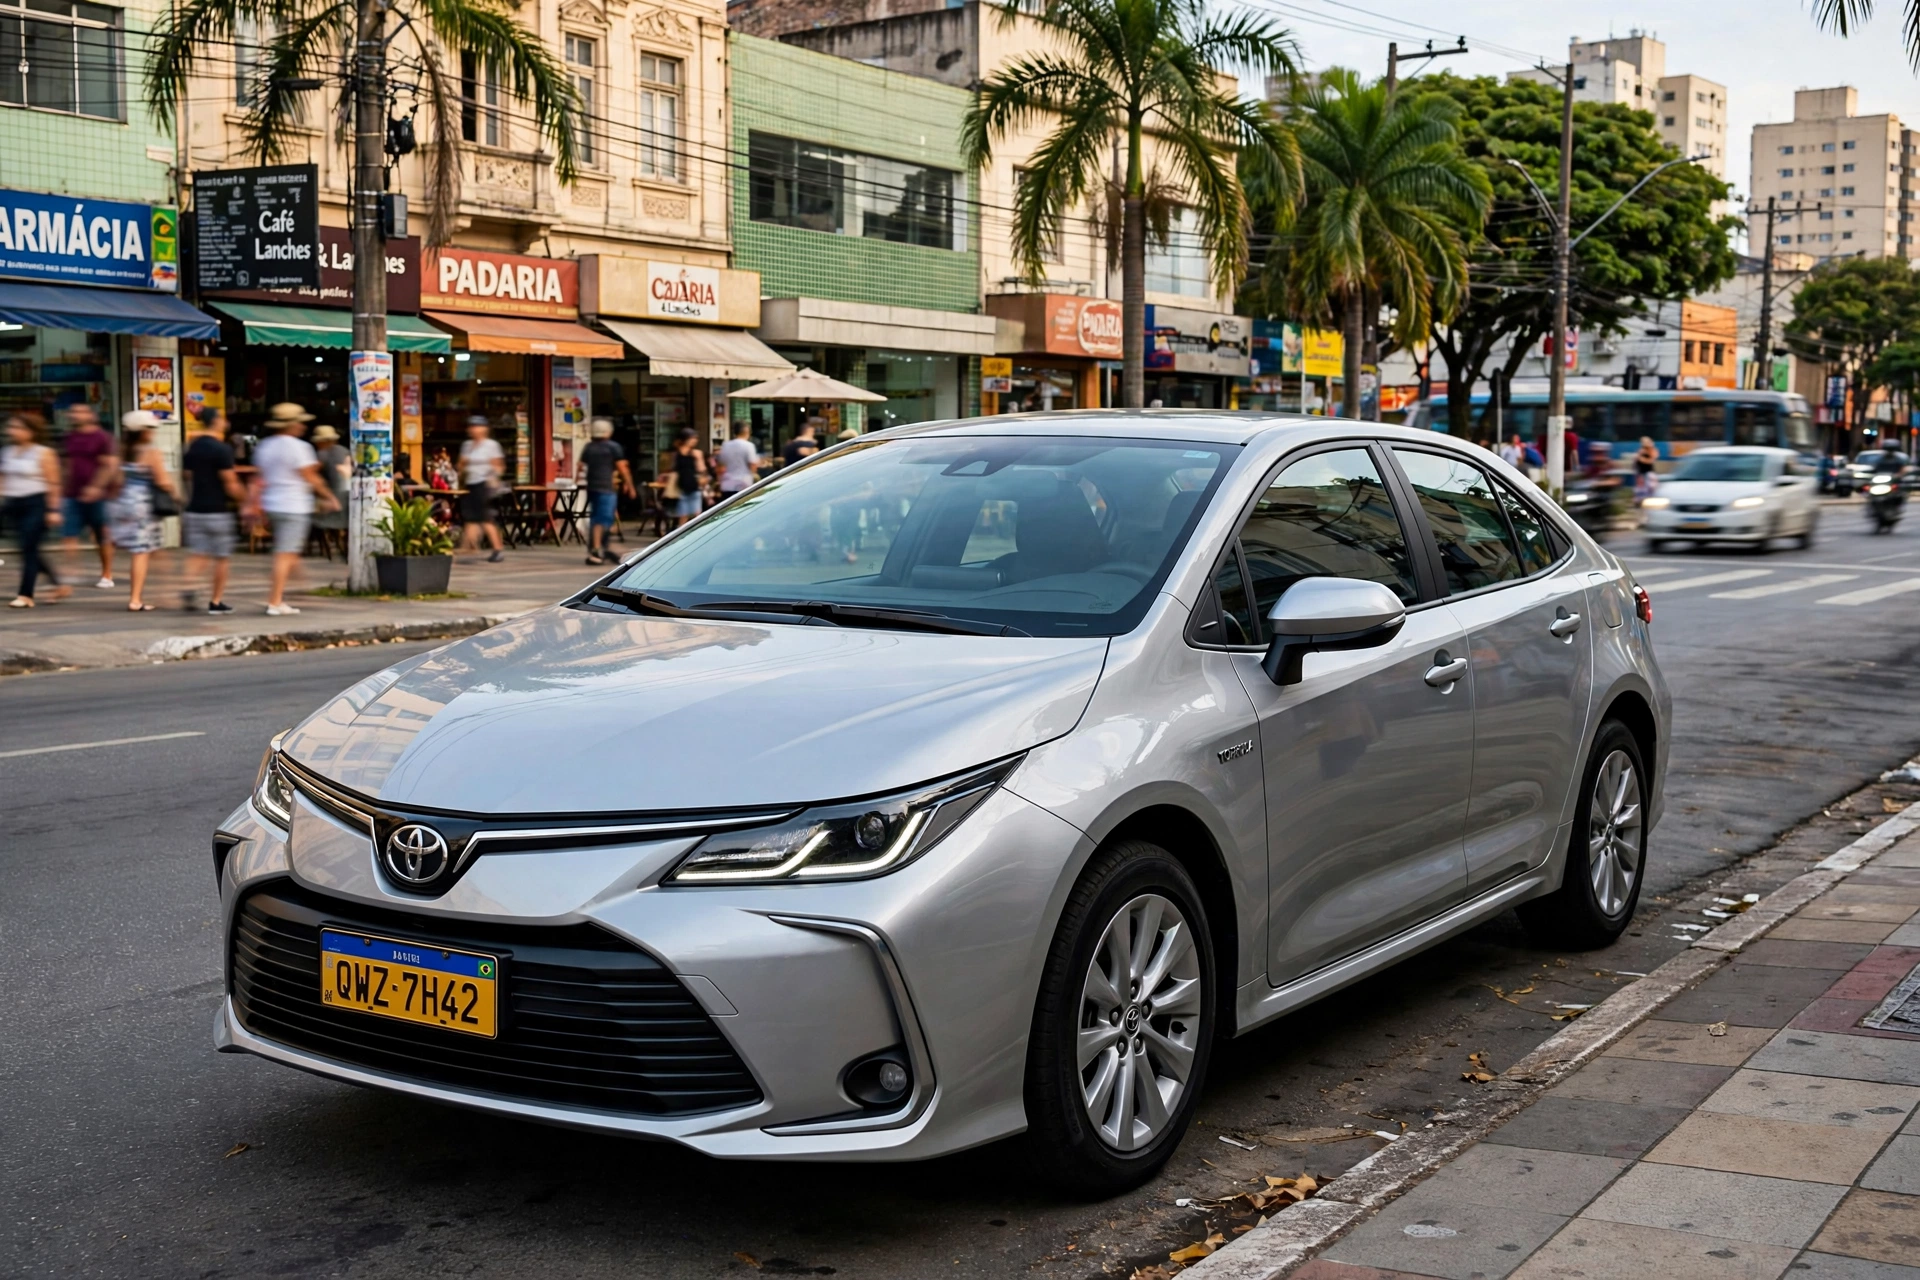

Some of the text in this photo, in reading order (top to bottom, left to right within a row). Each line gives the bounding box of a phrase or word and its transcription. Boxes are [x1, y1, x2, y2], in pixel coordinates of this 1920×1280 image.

[258, 209, 295, 233] Café
[255, 237, 311, 260] Lanches
[331, 242, 406, 275] Laes
[439, 256, 563, 303] PADARIA
